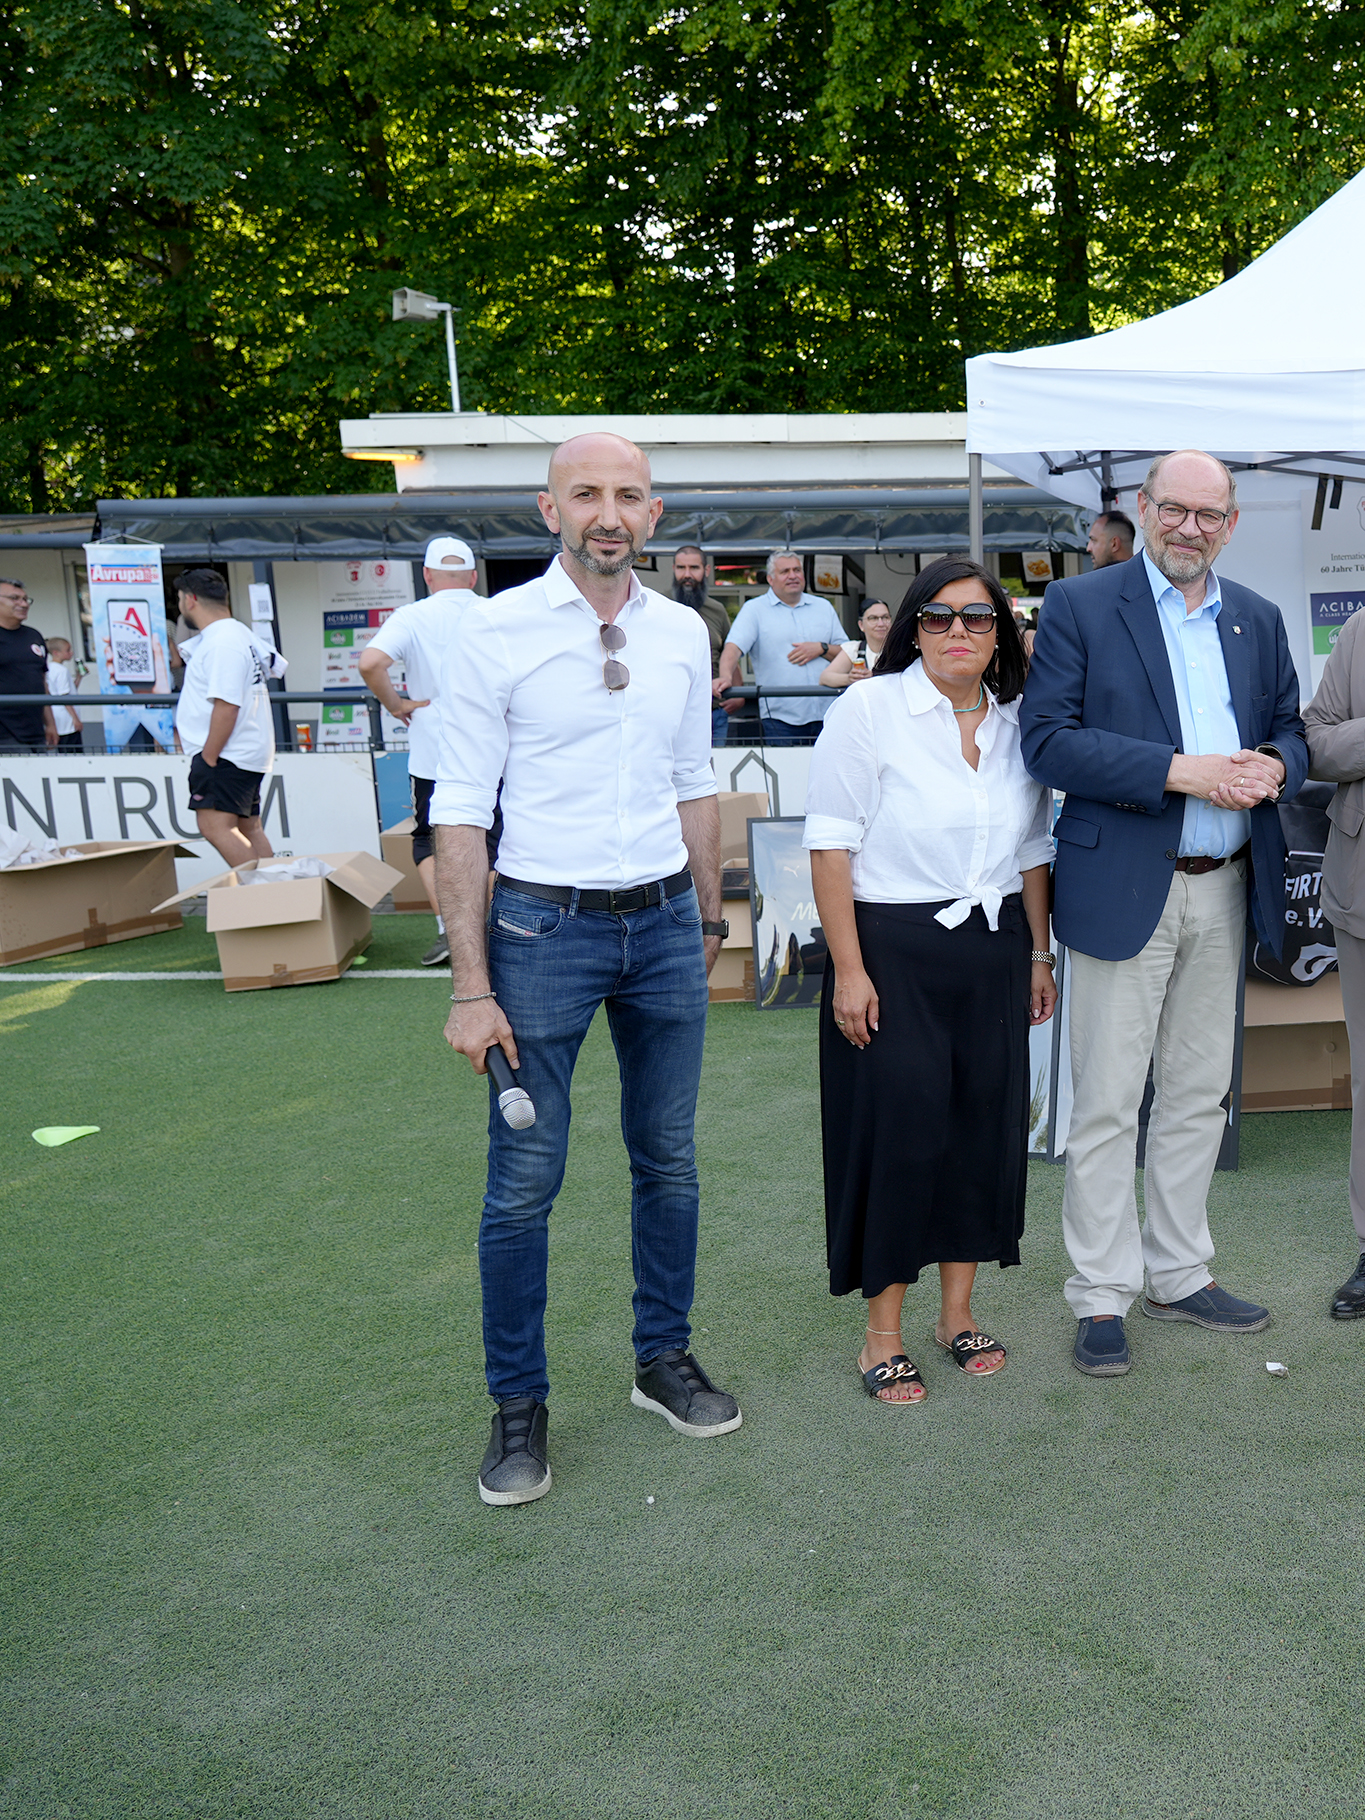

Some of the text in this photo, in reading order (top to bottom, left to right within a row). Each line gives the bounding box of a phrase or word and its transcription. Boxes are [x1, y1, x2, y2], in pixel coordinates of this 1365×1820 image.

[92, 565, 144, 583] Avrupa
[1320, 565, 1330, 573] 60
[1331, 565, 1353, 573] Jahre
[1285, 907, 1323, 928] e.V.
